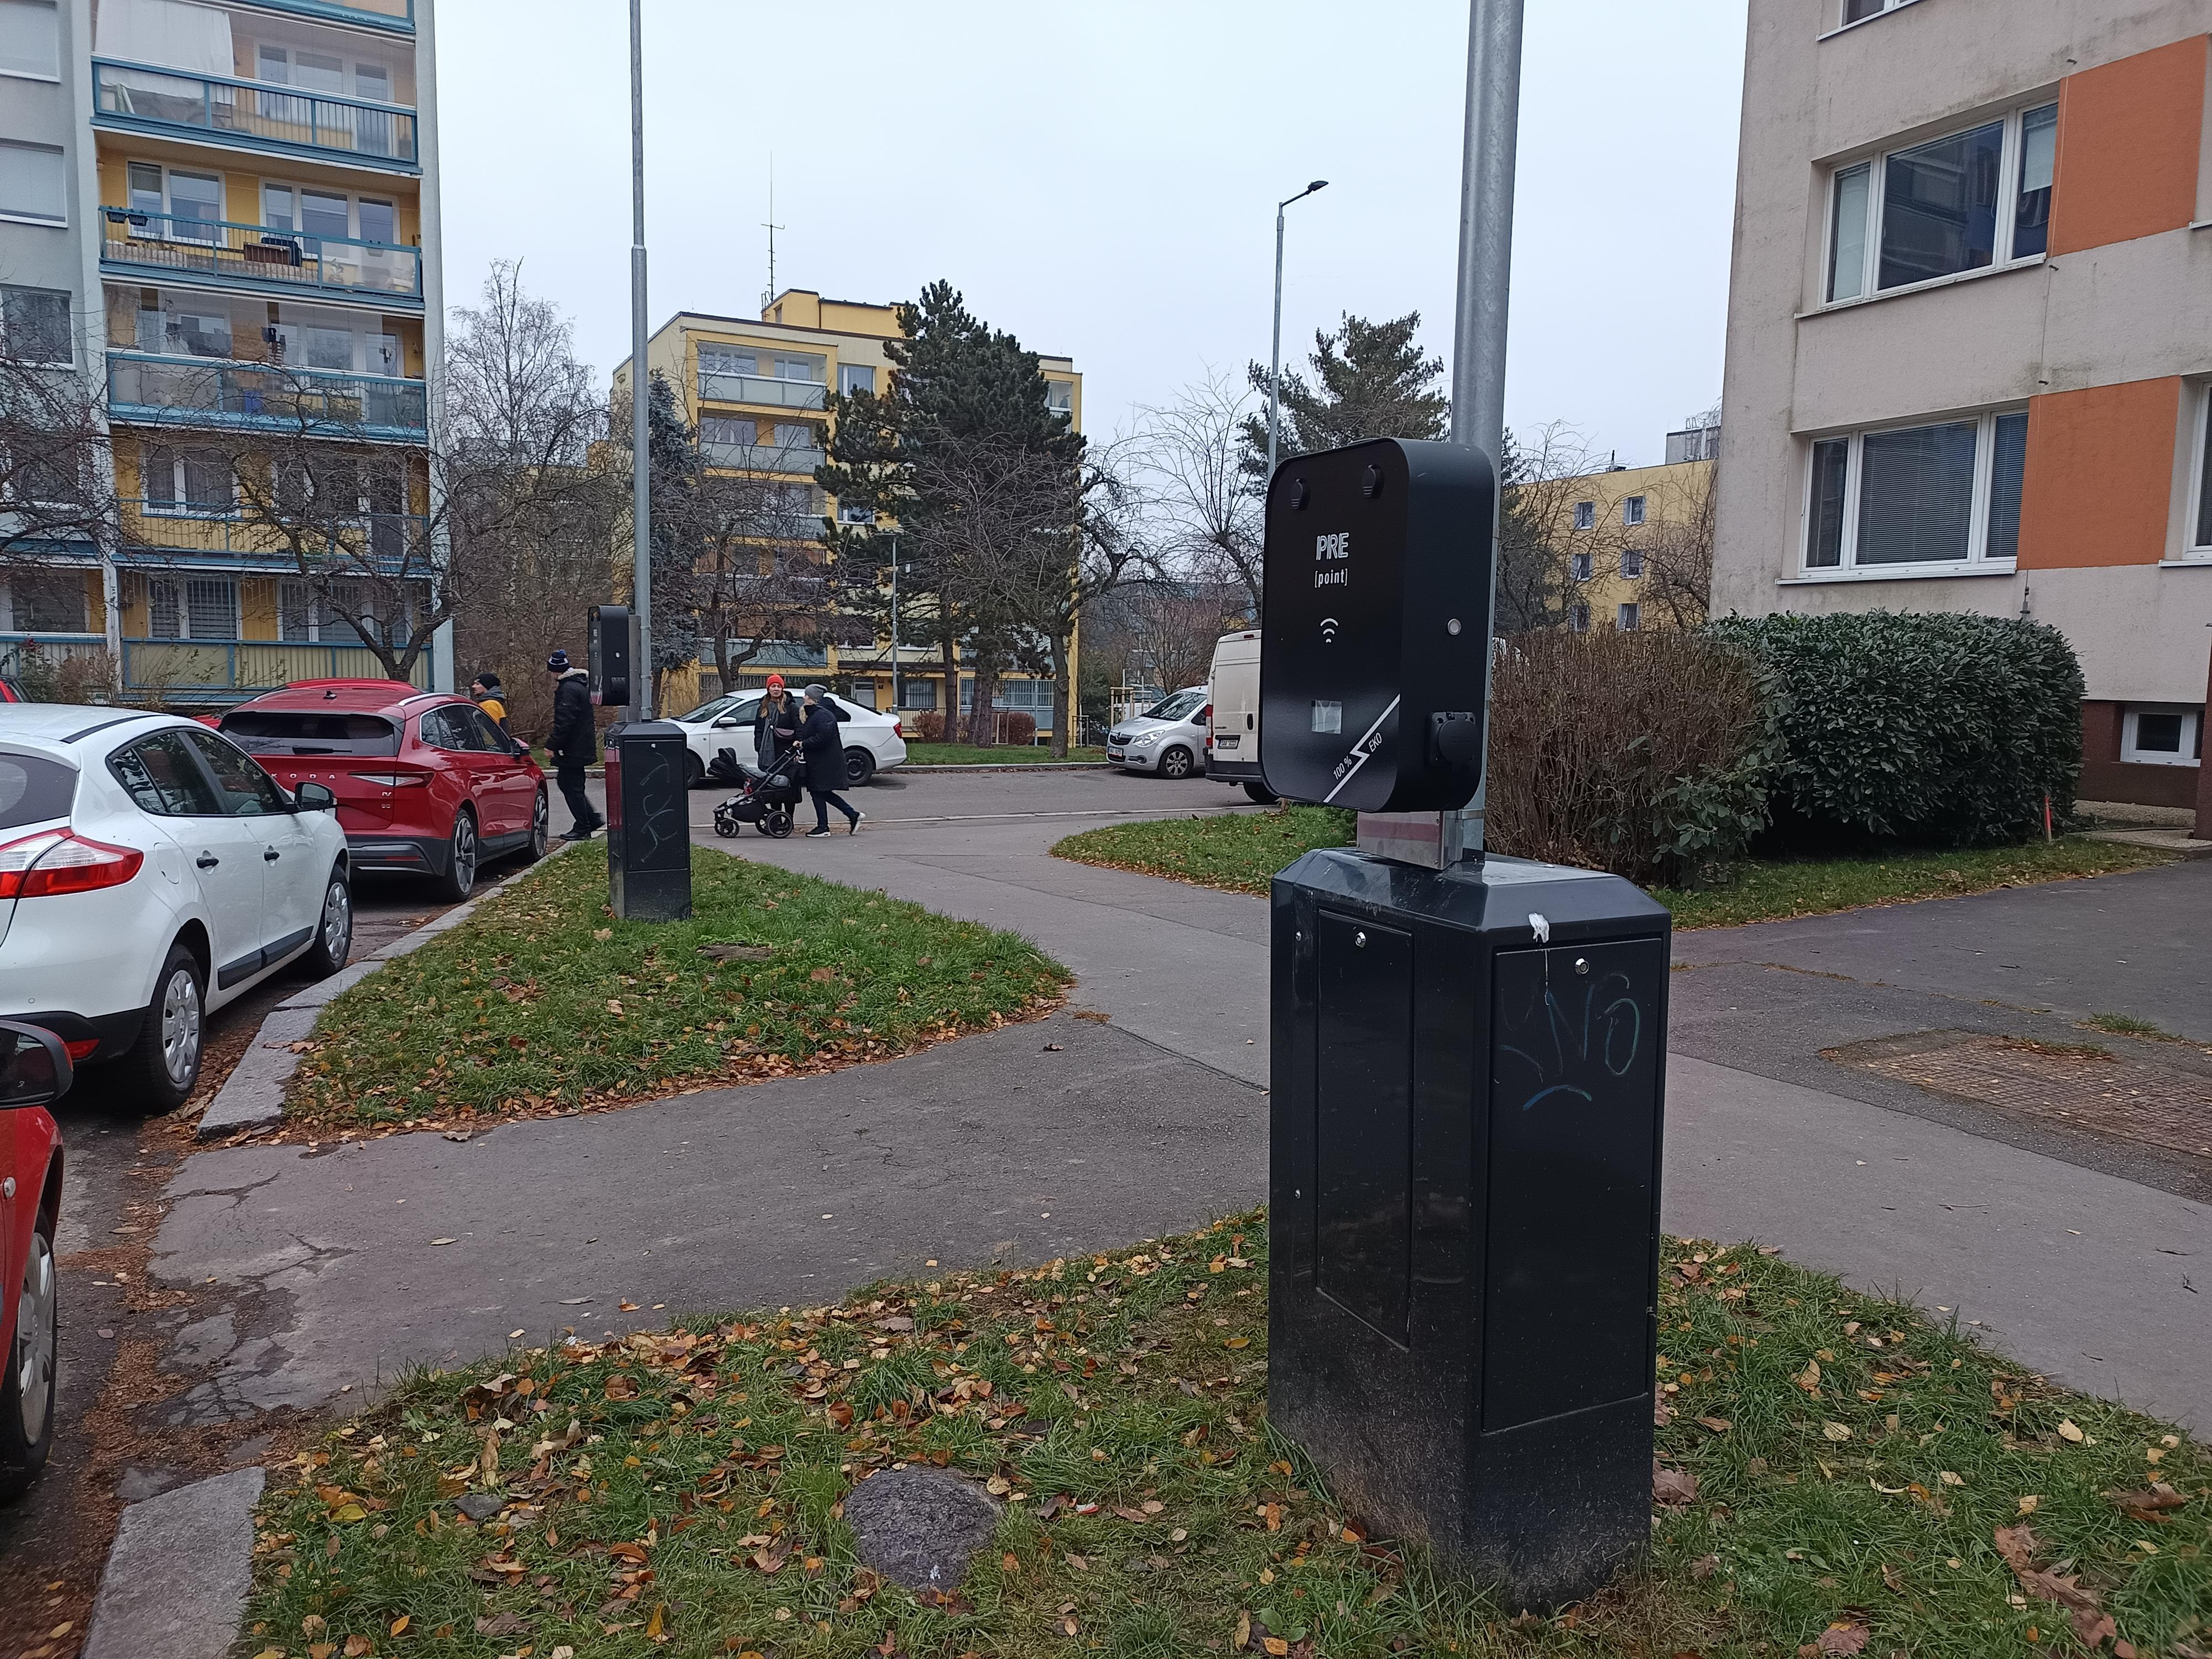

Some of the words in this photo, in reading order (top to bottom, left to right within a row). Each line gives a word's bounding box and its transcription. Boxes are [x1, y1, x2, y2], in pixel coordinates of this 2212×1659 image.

[1316, 533, 1349, 561] PRE
[1314, 568, 1348, 588] [point]
[1333, 763, 1345, 780] 100
[1343, 755, 1352, 768] %
[1368, 732, 1383, 753] EKO
